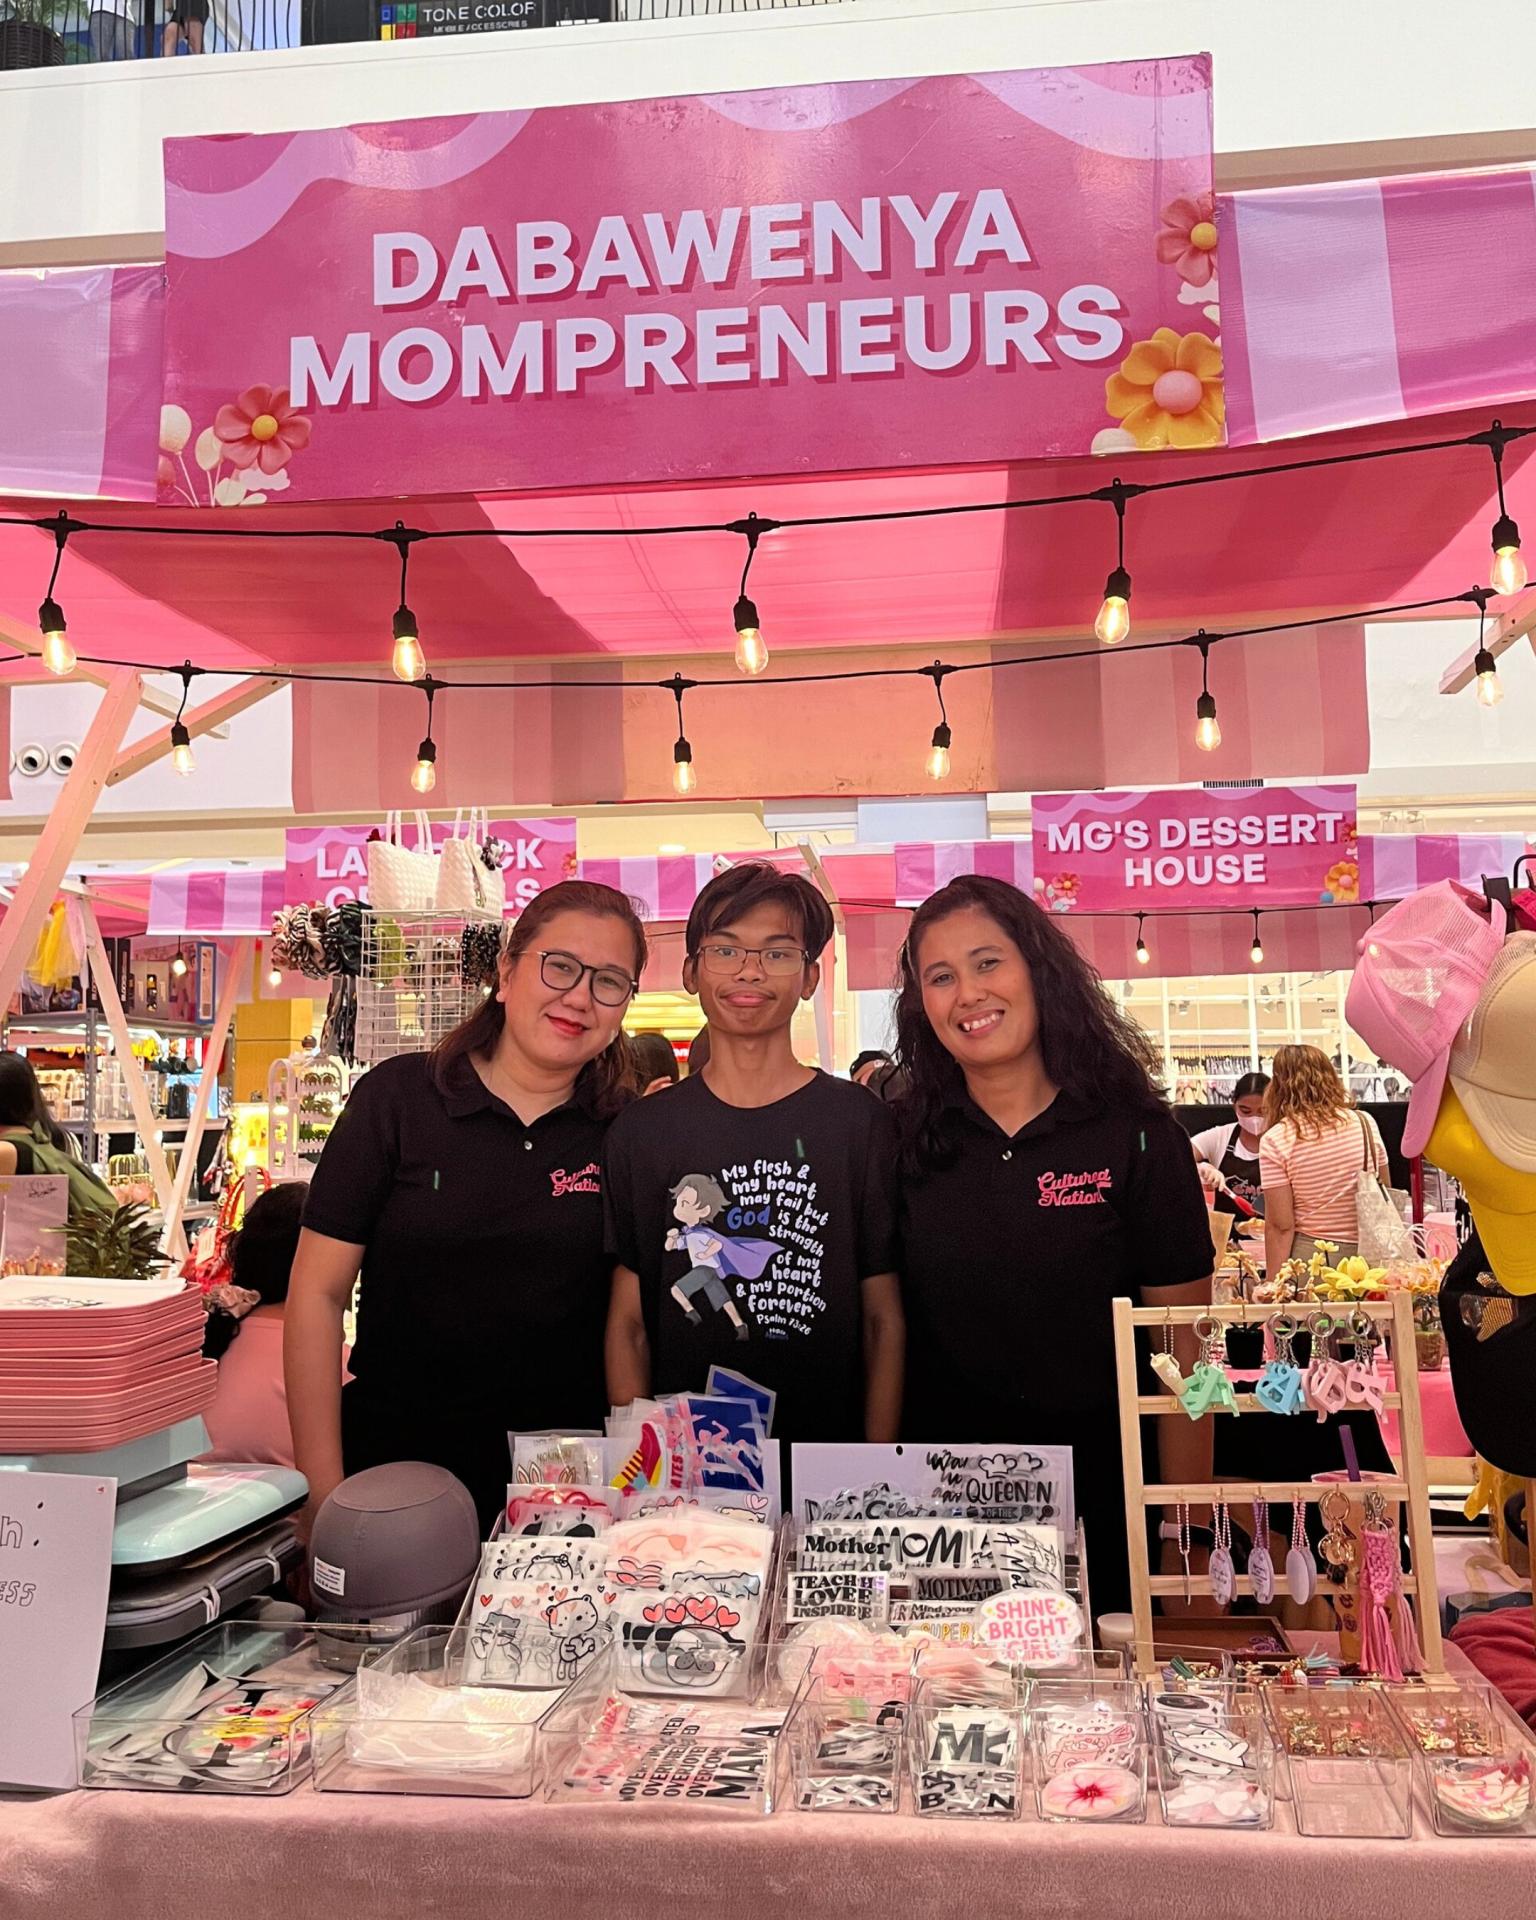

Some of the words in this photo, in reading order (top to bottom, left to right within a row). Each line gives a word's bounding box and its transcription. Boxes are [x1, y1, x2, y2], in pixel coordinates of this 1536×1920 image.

[422, 6, 469, 23] TONE
[372, 188, 1032, 307] DABAWENYA
[289, 284, 1124, 408] MOMPRENEURS
[1048, 820, 1150, 852] MG'S
[1160, 812, 1344, 848] DESSERT
[1125, 854, 1267, 887] HOUSE
[721, 1165, 748, 1182] My
[754, 1159, 792, 1176] flesh
[797, 1164, 811, 1180] &
[1037, 1169, 1111, 1192] Cultured
[732, 1178, 760, 1195] my
[767, 1177, 817, 1200] heart
[727, 1205, 771, 1230] God
[778, 1209, 791, 1225] is
[795, 1215, 818, 1234] the
[740, 1193, 770, 1206] may
[776, 1192, 803, 1211] fail
[804, 1203, 829, 1226] but
[769, 1225, 824, 1257] strength
[777, 1251, 793, 1265] of
[797, 1255, 820, 1270] my
[772, 1264, 822, 1287] heart
[736, 1283, 747, 1297] &
[750, 1281, 773, 1295] my
[777, 1282, 827, 1312] portion
[756, 1313, 787, 1325] Psalm
[804, 1535, 890, 1554] Mother
[794, 1574, 857, 1589] TEACH
[995, 1598, 1057, 1620] SHINE
[989, 1616, 1069, 1640] BRIGHT
